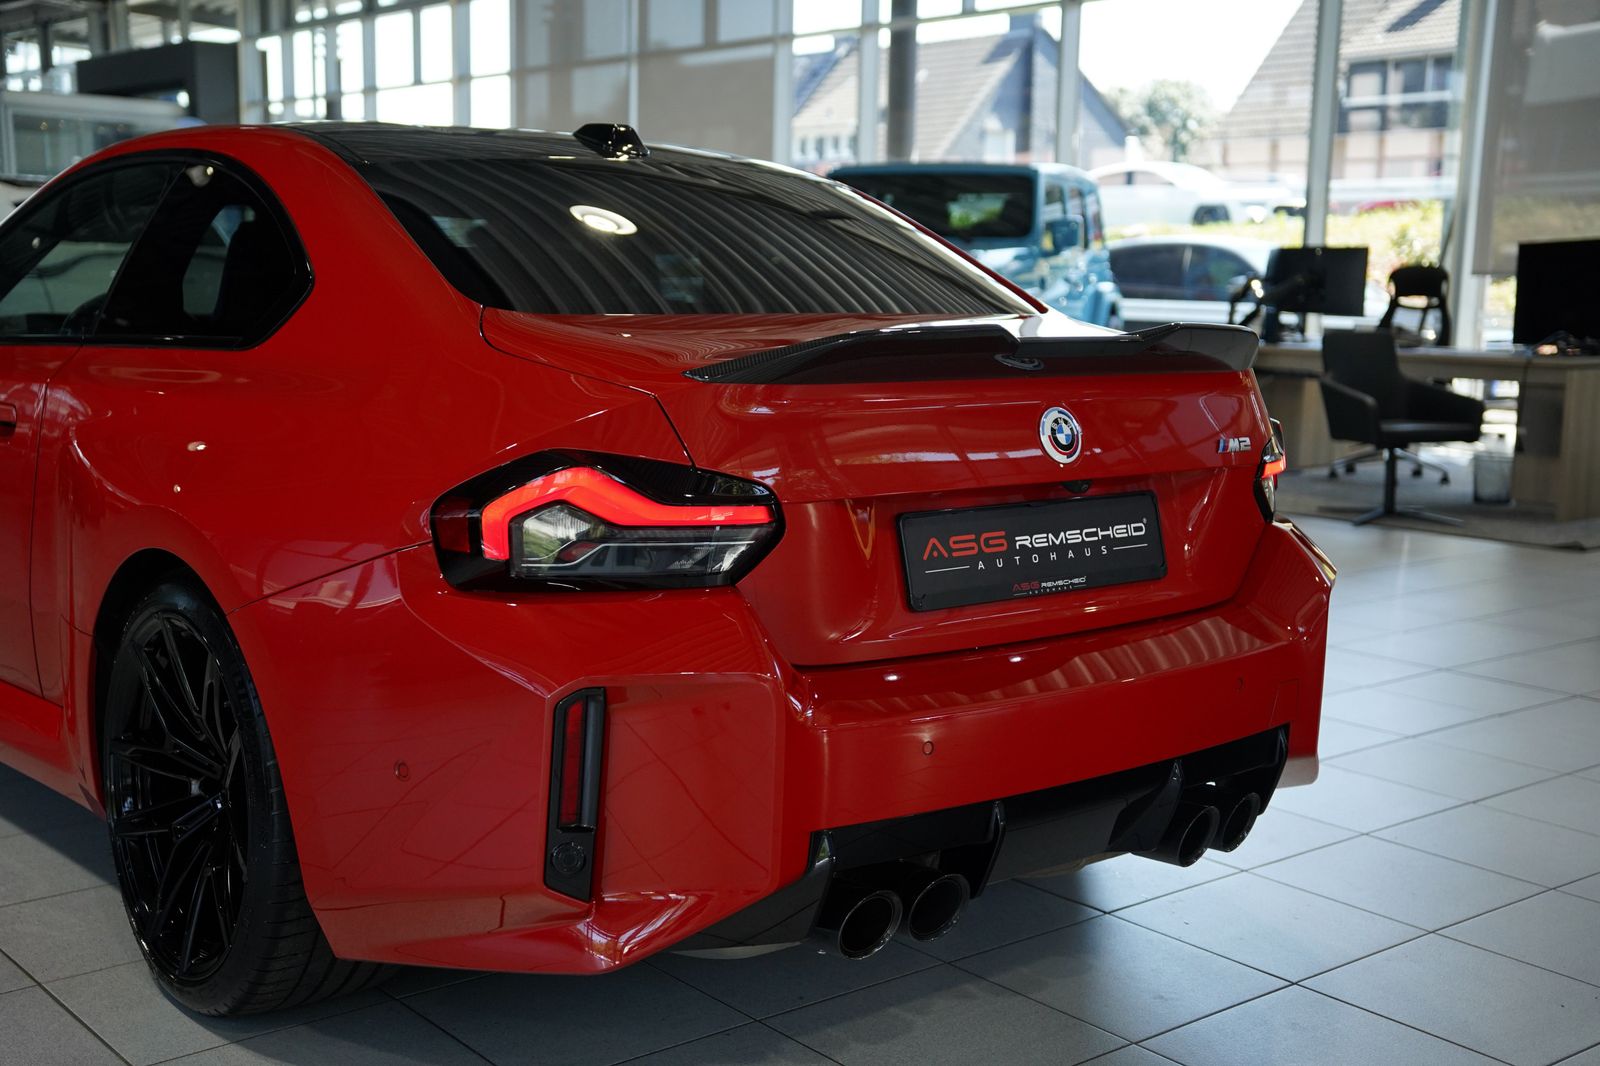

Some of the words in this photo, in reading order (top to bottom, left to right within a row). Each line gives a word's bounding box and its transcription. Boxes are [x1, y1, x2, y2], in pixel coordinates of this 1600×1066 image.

[1220, 436, 1251, 453] M2
[922, 530, 1009, 561] ASG
[977, 545, 1108, 570] AUTOHAUS
[1012, 581, 1041, 592] ASG
